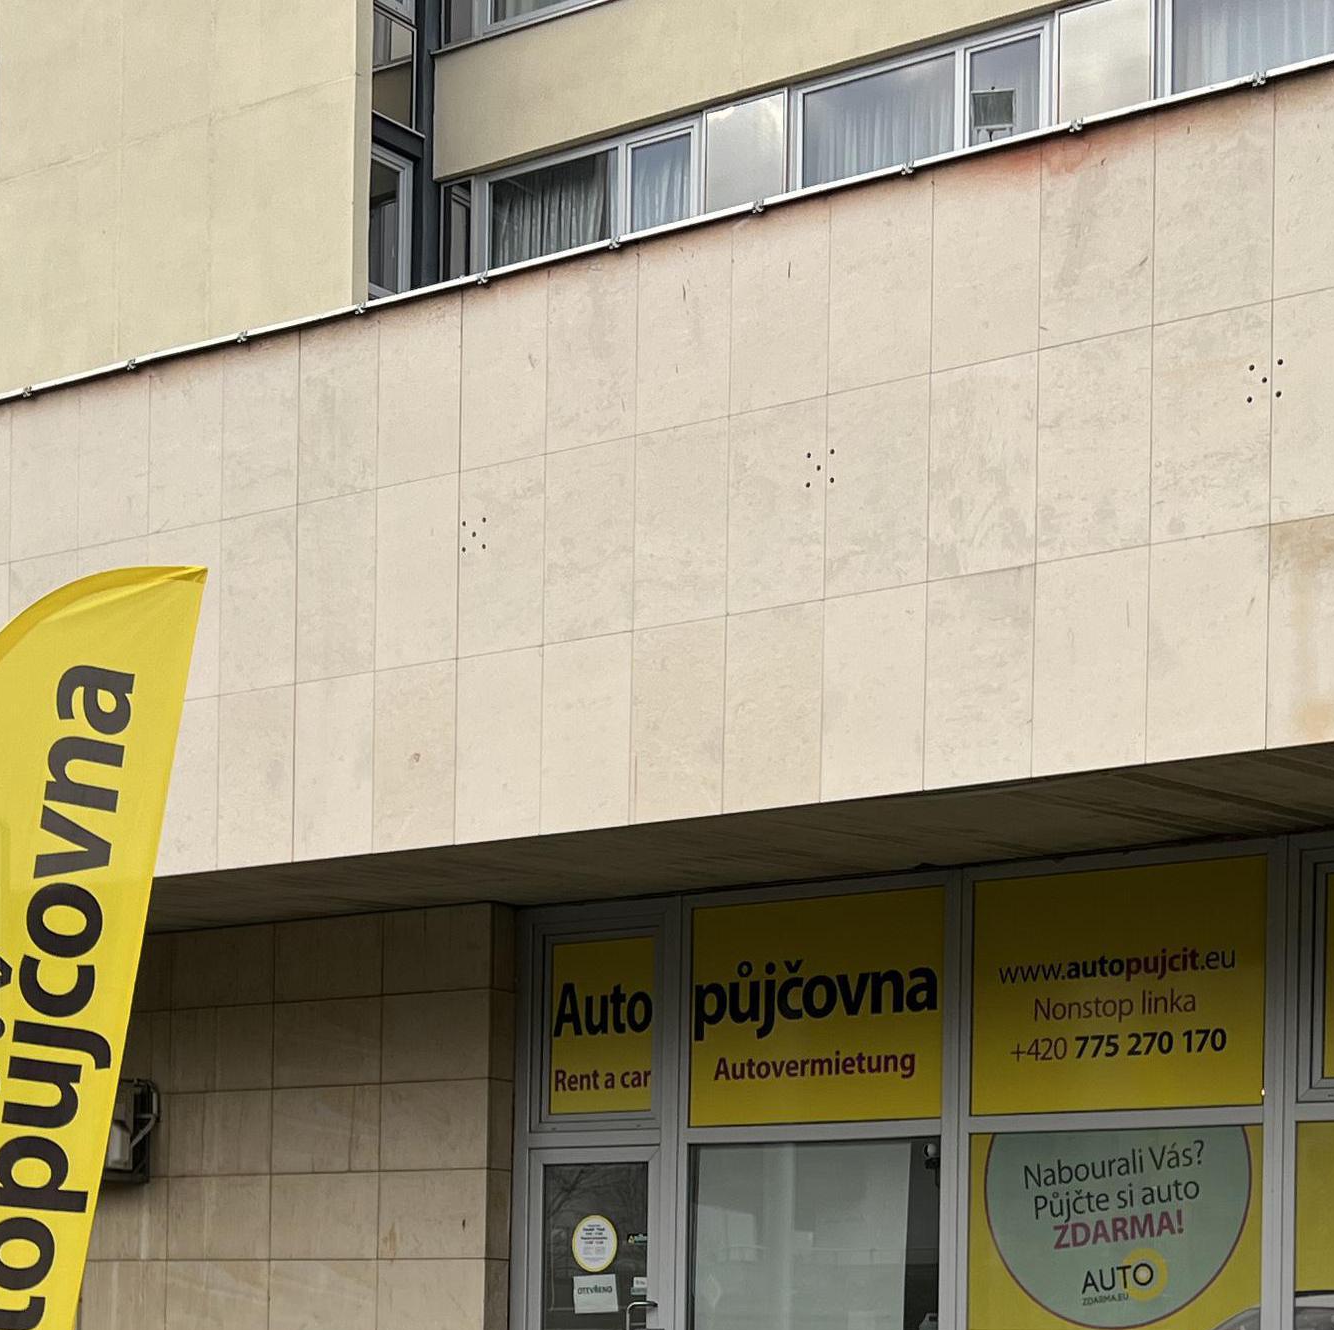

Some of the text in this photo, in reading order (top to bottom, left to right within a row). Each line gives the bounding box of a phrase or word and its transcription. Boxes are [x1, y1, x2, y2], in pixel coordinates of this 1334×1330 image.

[999, 947, 1236, 984] www.autopujcit.eu
[553, 959, 939, 1042] Auto půjčovna
[1034, 988, 1197, 1022] Nonstop linka
[1010, 1028, 1227, 1062] +420 775 270 170
[554, 1069, 652, 1092] Rent a car
[713, 1050, 917, 1082] Autovermietung
[1024, 1139, 1205, 1189] Nabourali Vás?
[1034, 1179, 1200, 1223] Půjčte si auto
[1053, 1209, 1185, 1250] ZDARMA!
[1082, 1262, 1154, 1295] AUTO
